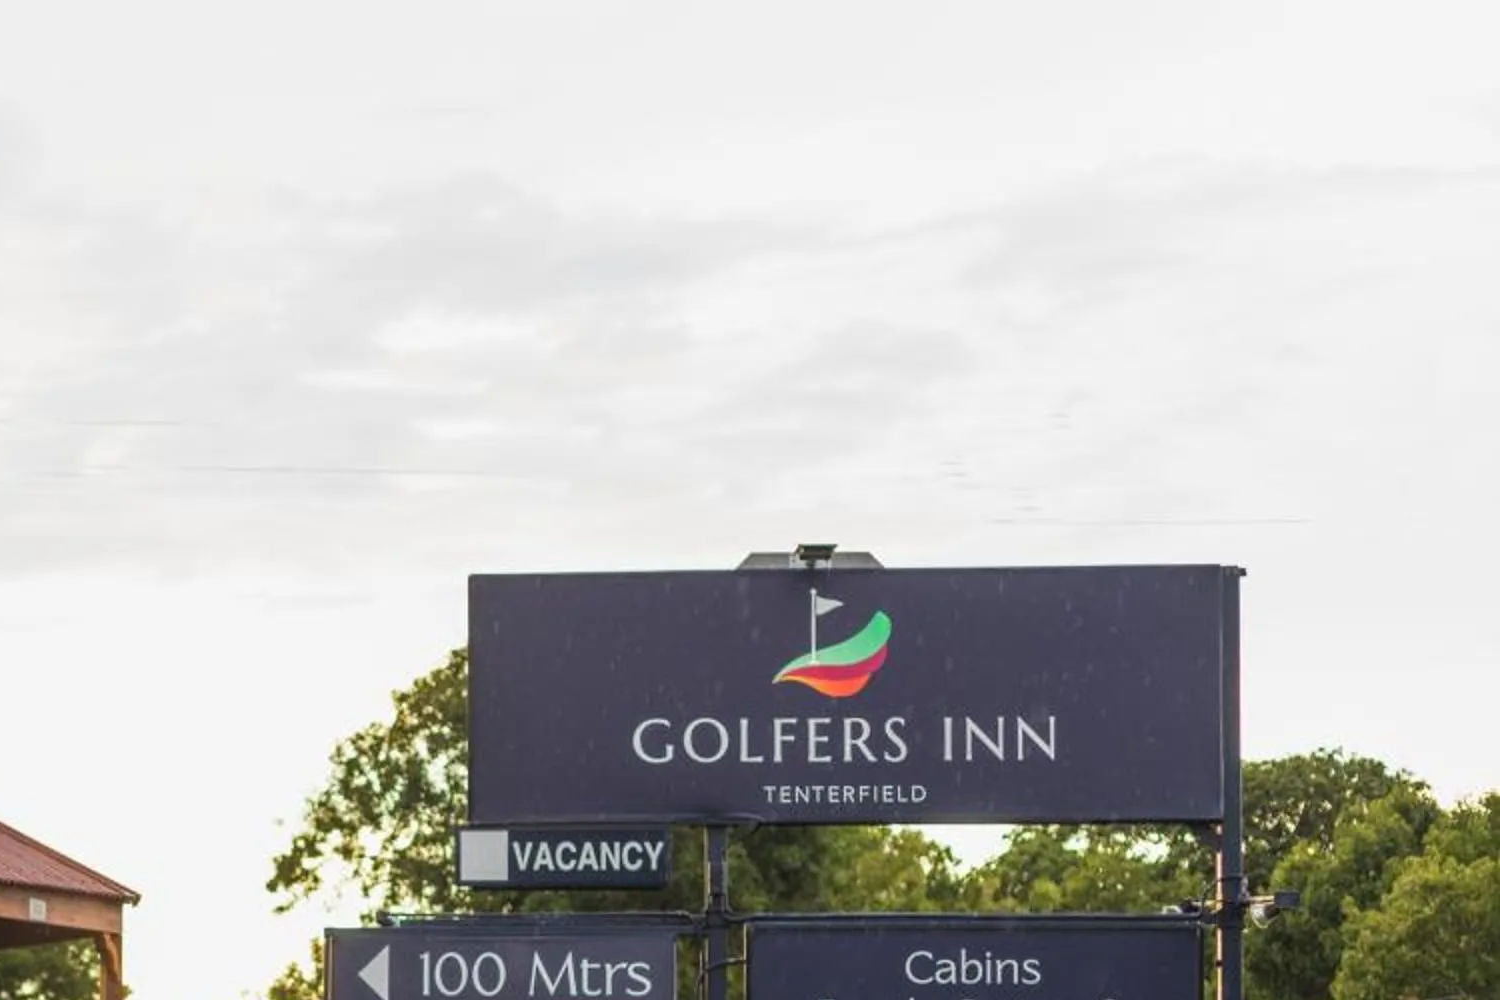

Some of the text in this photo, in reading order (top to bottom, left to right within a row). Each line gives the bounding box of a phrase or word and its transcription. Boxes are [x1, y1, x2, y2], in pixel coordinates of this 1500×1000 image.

[632, 715, 1057, 764] GOLFERS INN
[763, 785, 928, 804] TENTERFIELD
[512, 841, 665, 872] VACANCY
[419, 951, 652, 998] 100 Mtrs
[905, 948, 1041, 986] Cabins
